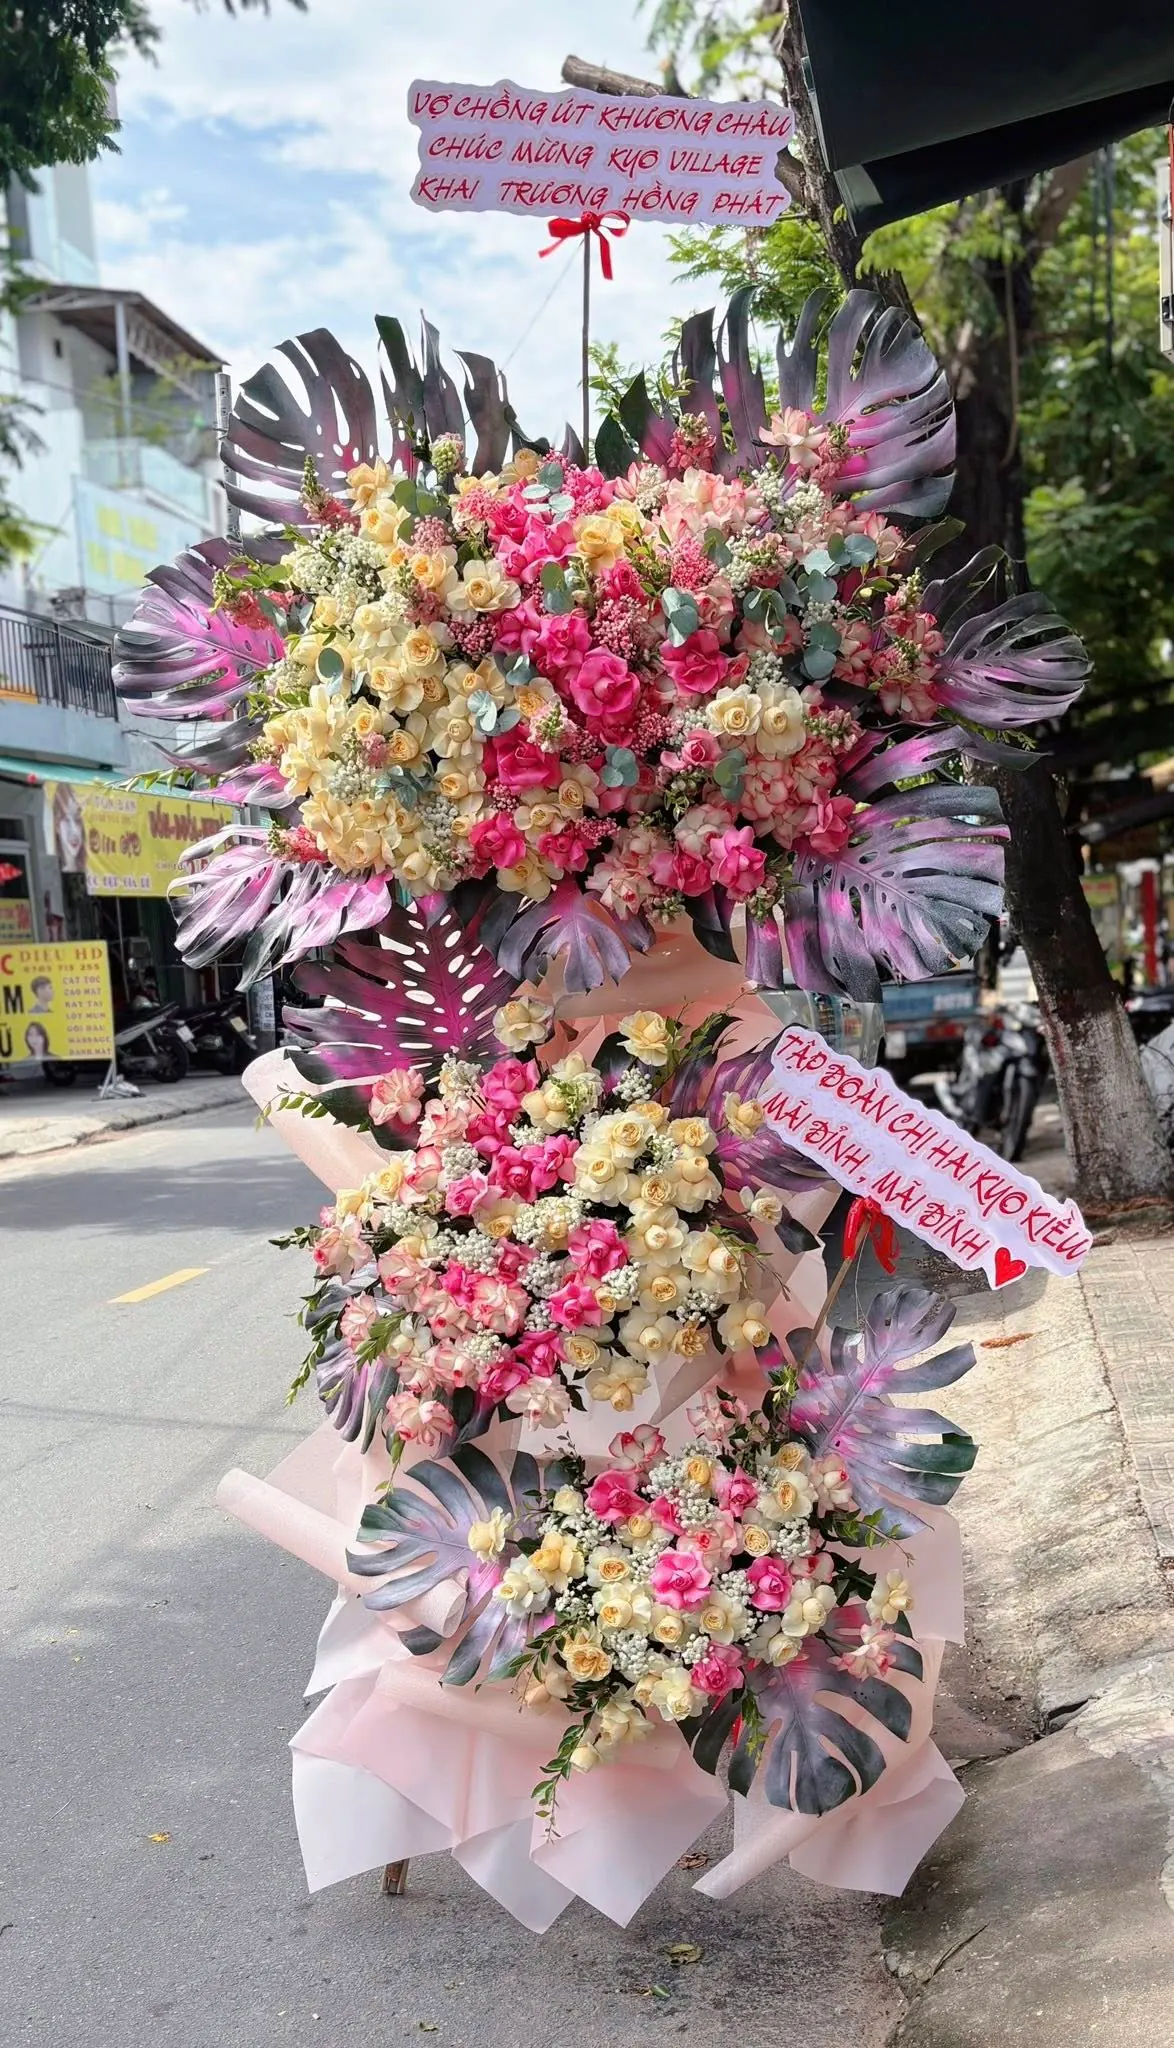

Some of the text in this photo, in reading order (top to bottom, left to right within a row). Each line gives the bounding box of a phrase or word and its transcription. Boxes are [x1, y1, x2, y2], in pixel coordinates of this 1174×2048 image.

[414, 89, 793, 137] VỢ CHỒNG ÚT KHƯƠNG CHÂU
[428, 133, 764, 179] CHÚC MỪNG KYO VILLAGE
[417, 176, 481, 202] KHAI
[622, 181, 700, 214] HỒNG
[712, 188, 785, 215] PHÁT
[776, 1034, 828, 1073] TẬP
[818, 1063, 899, 1124] ĐOÀN
[887, 1113, 939, 1155] CHỊ
[926, 1138, 981, 1182] HAI
[969, 1168, 1028, 1218] KYO
[762, 1091, 813, 1132] MÃI
[871, 1170, 927, 1214] MÃI
[917, 1202, 991, 1261] ĐỈNH
